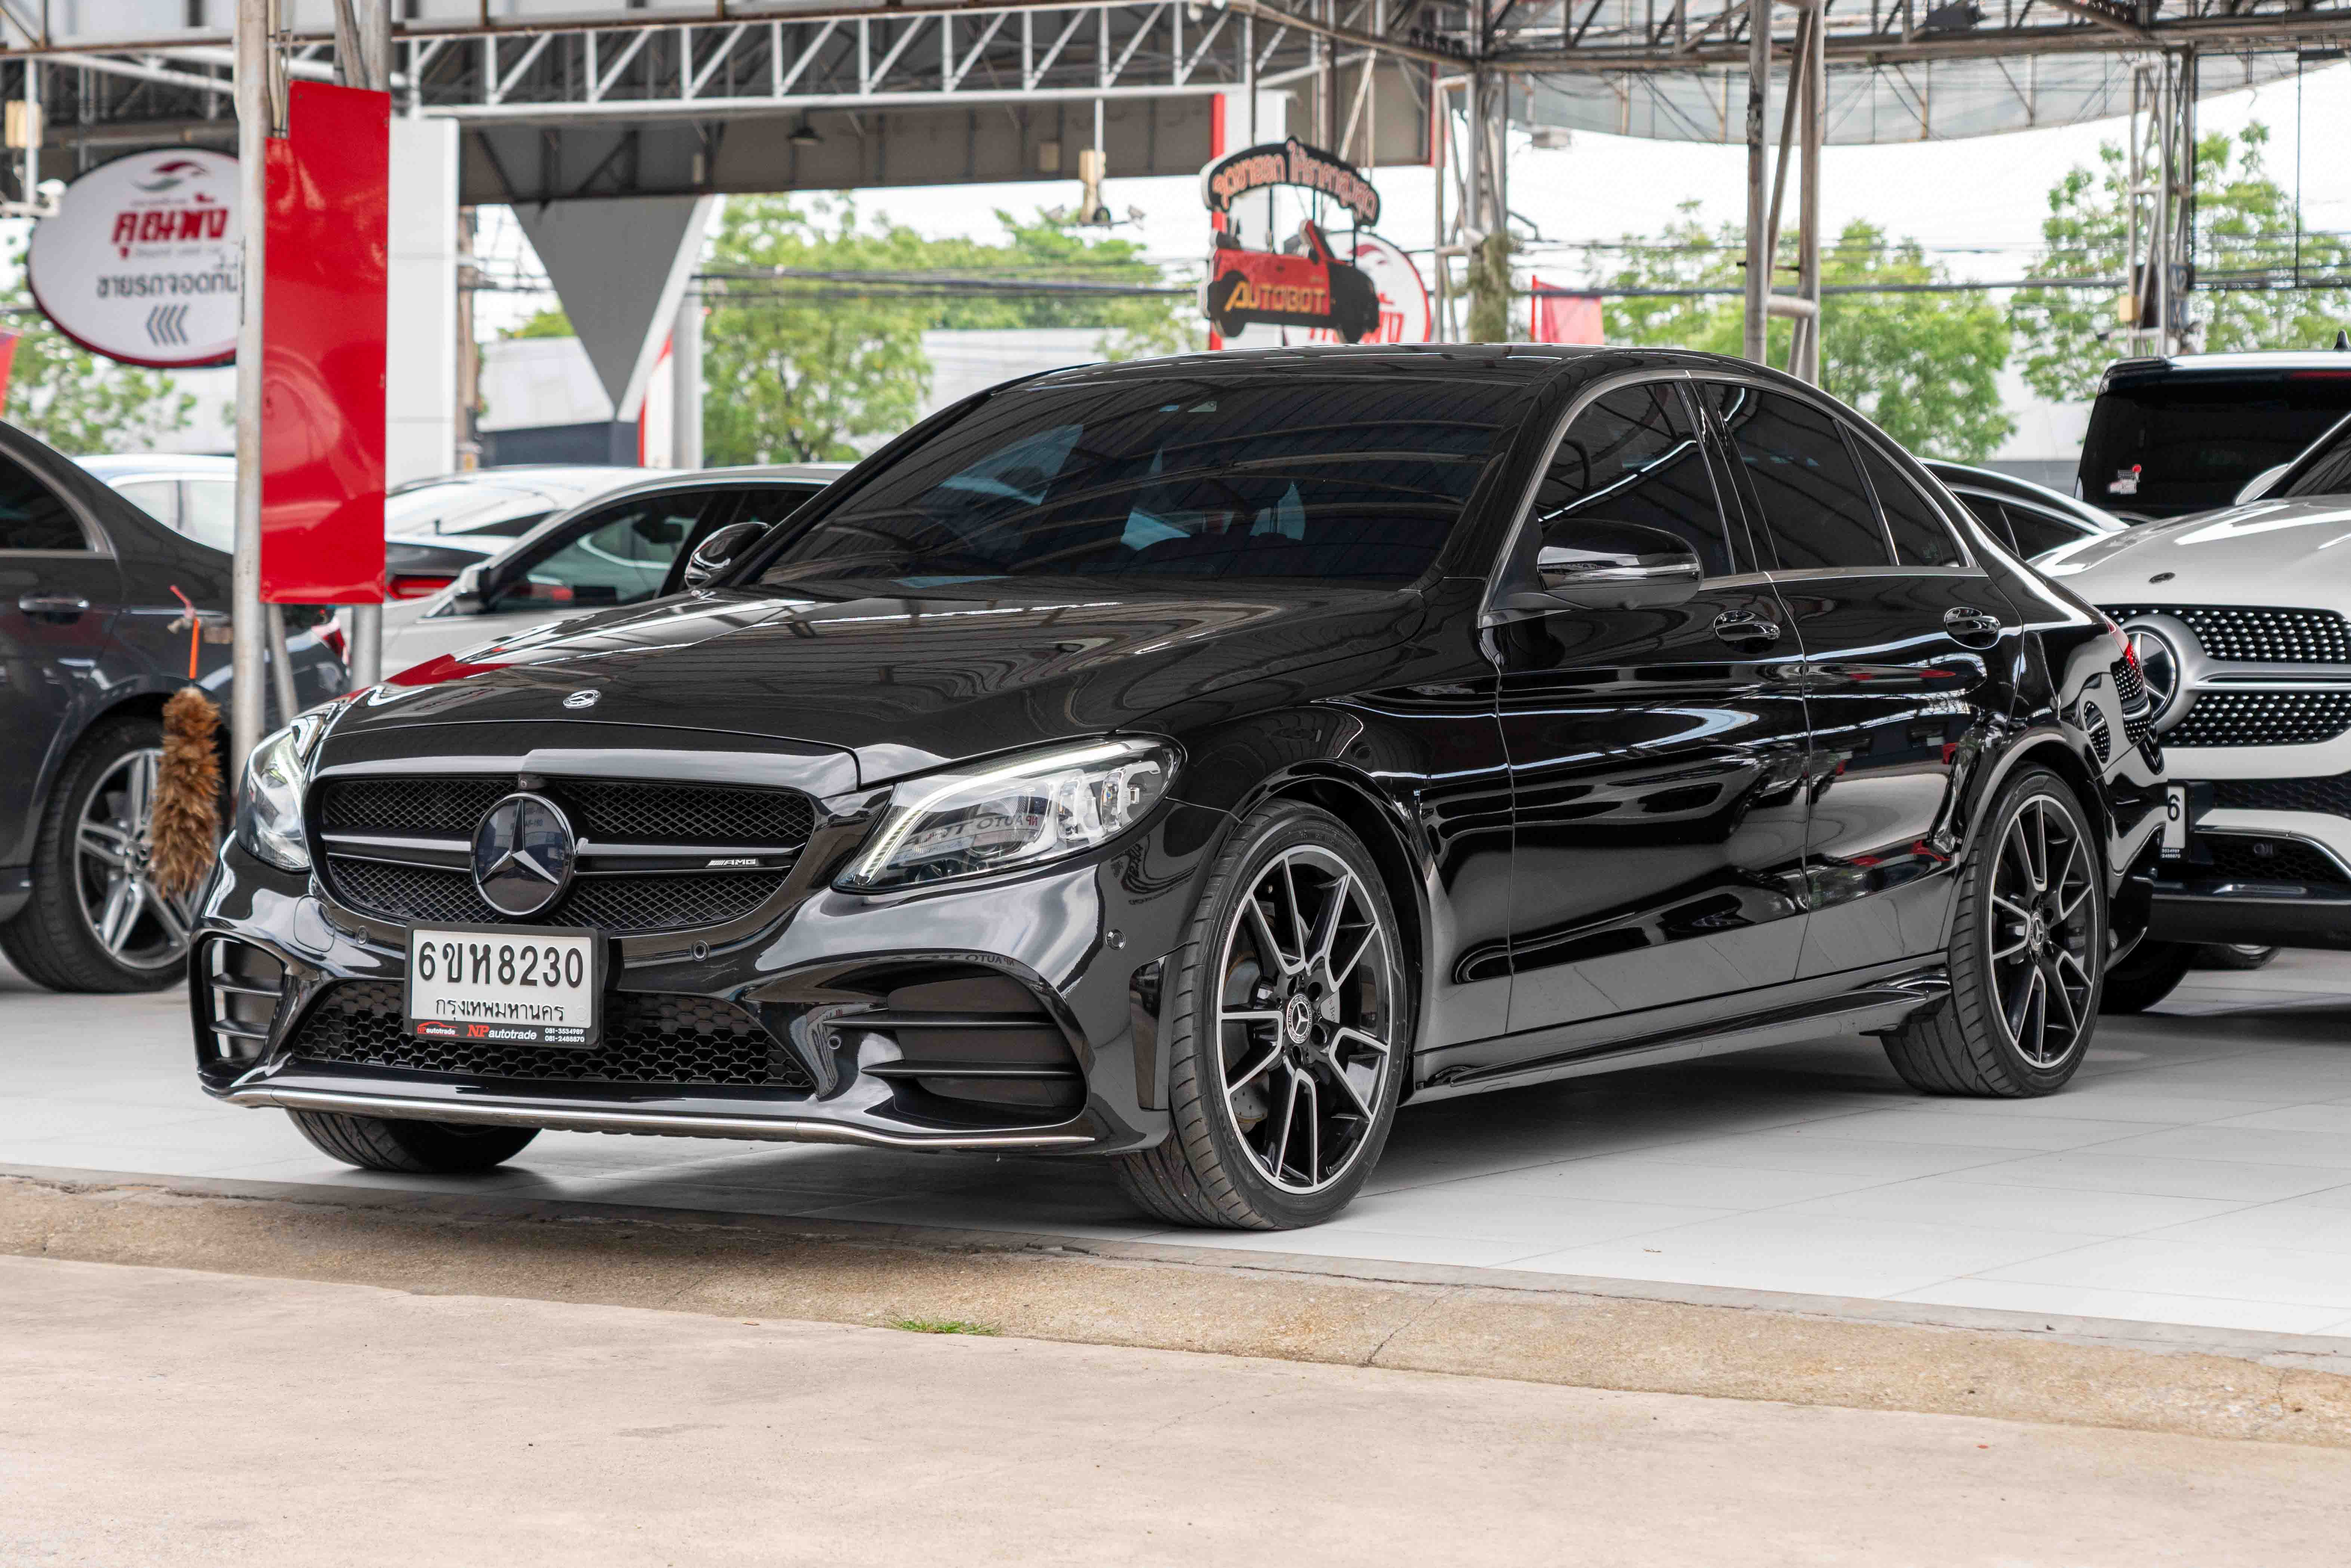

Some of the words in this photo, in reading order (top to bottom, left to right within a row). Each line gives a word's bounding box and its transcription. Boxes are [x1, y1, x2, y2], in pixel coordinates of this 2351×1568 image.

[1224, 280, 1325, 313] AUTOBOT
[435, 998, 565, 1021] กรุงเทพมหานคร
